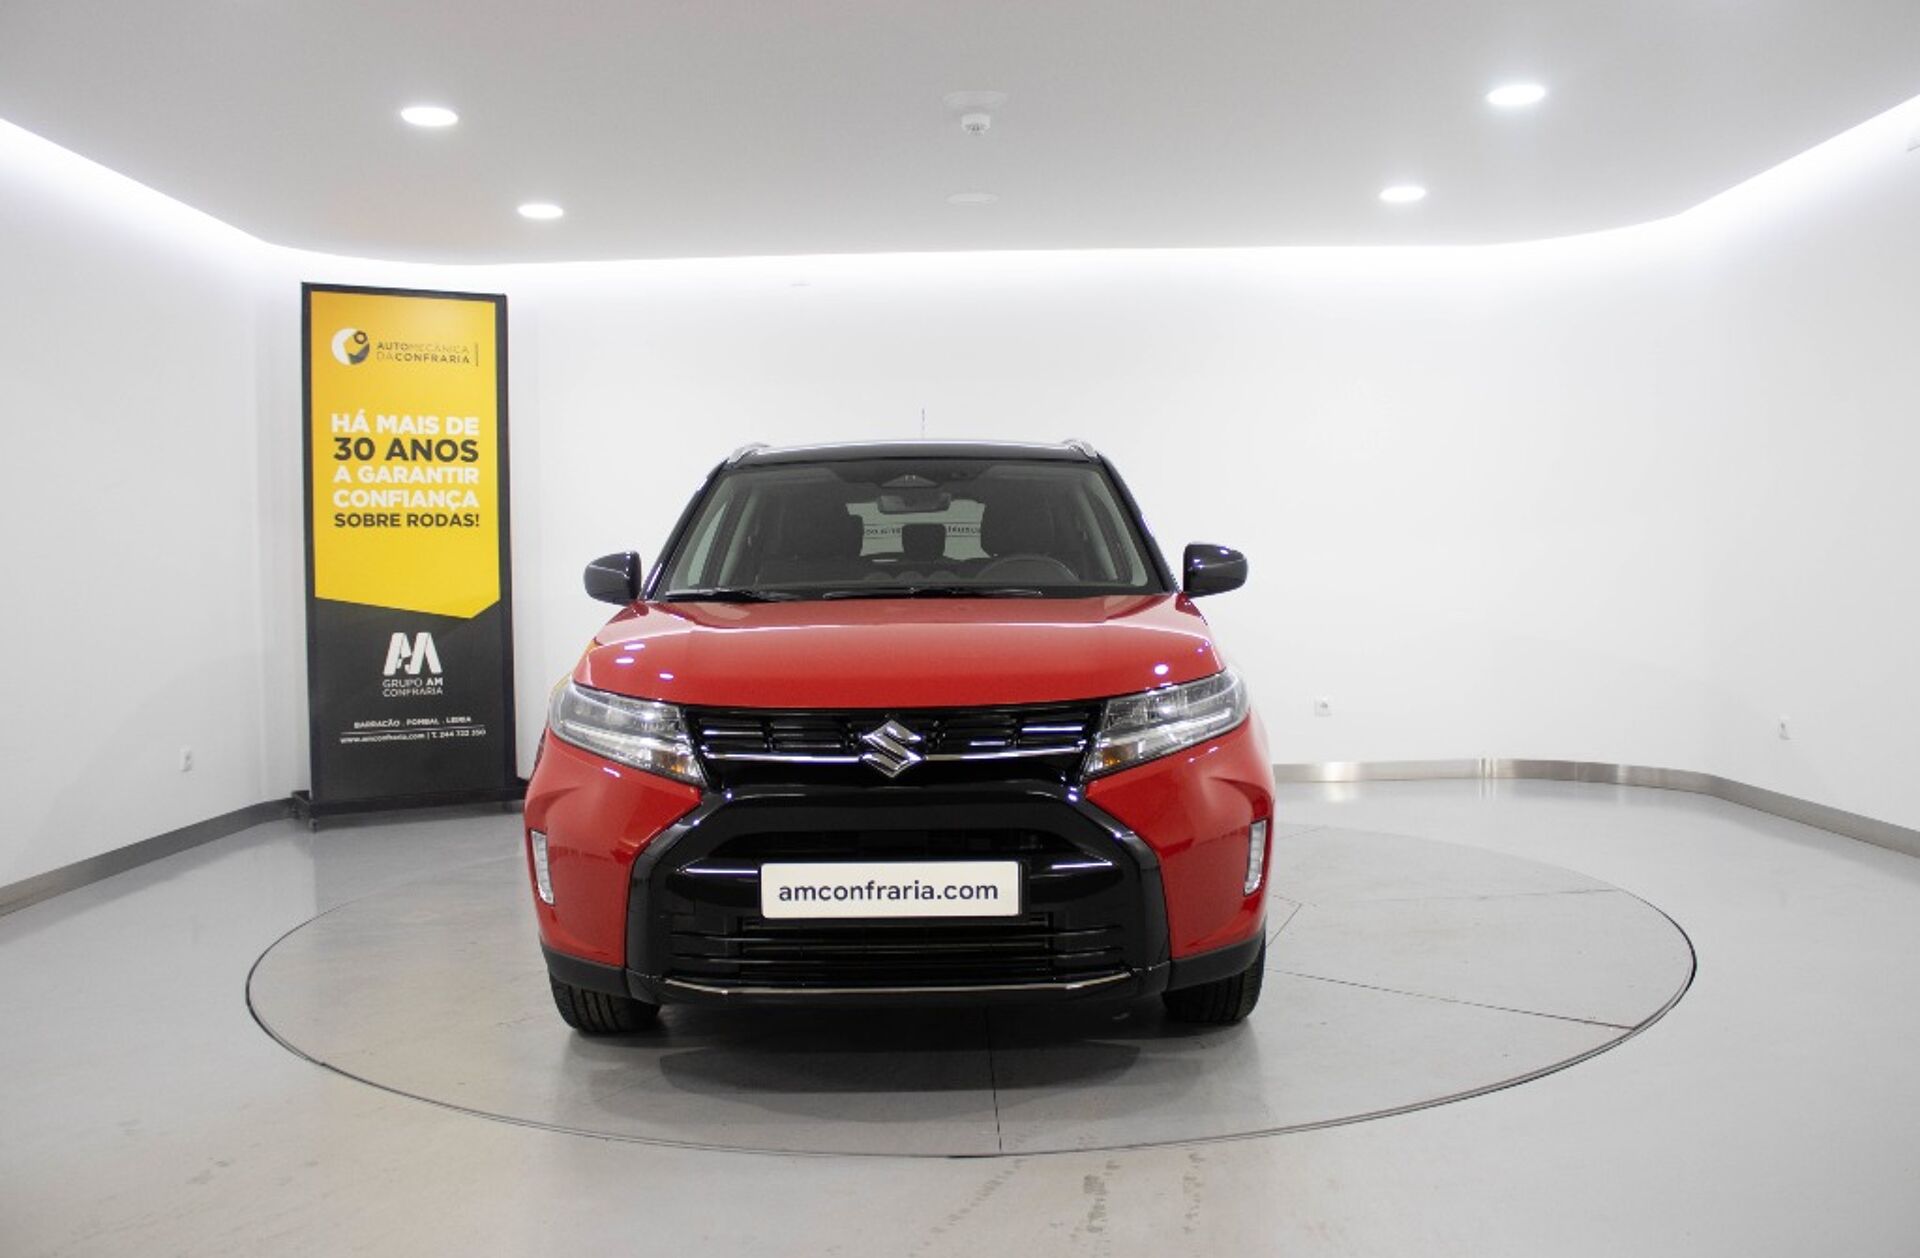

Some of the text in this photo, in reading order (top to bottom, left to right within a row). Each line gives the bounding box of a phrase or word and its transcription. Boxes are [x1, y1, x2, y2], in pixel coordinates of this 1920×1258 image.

[331, 409, 479, 435] HÁ MAIS DE
[333, 437, 478, 462] 30 ANOS
[333, 465, 478, 484] A GARANTIR
[333, 489, 479, 510] CONFIANÇA
[334, 512, 479, 527] SOBRE RODAS!
[382, 677, 443, 688] GRUPO AM
[382, 687, 443, 697] CONFRARIA
[778, 879, 999, 901] amconfraria.com
